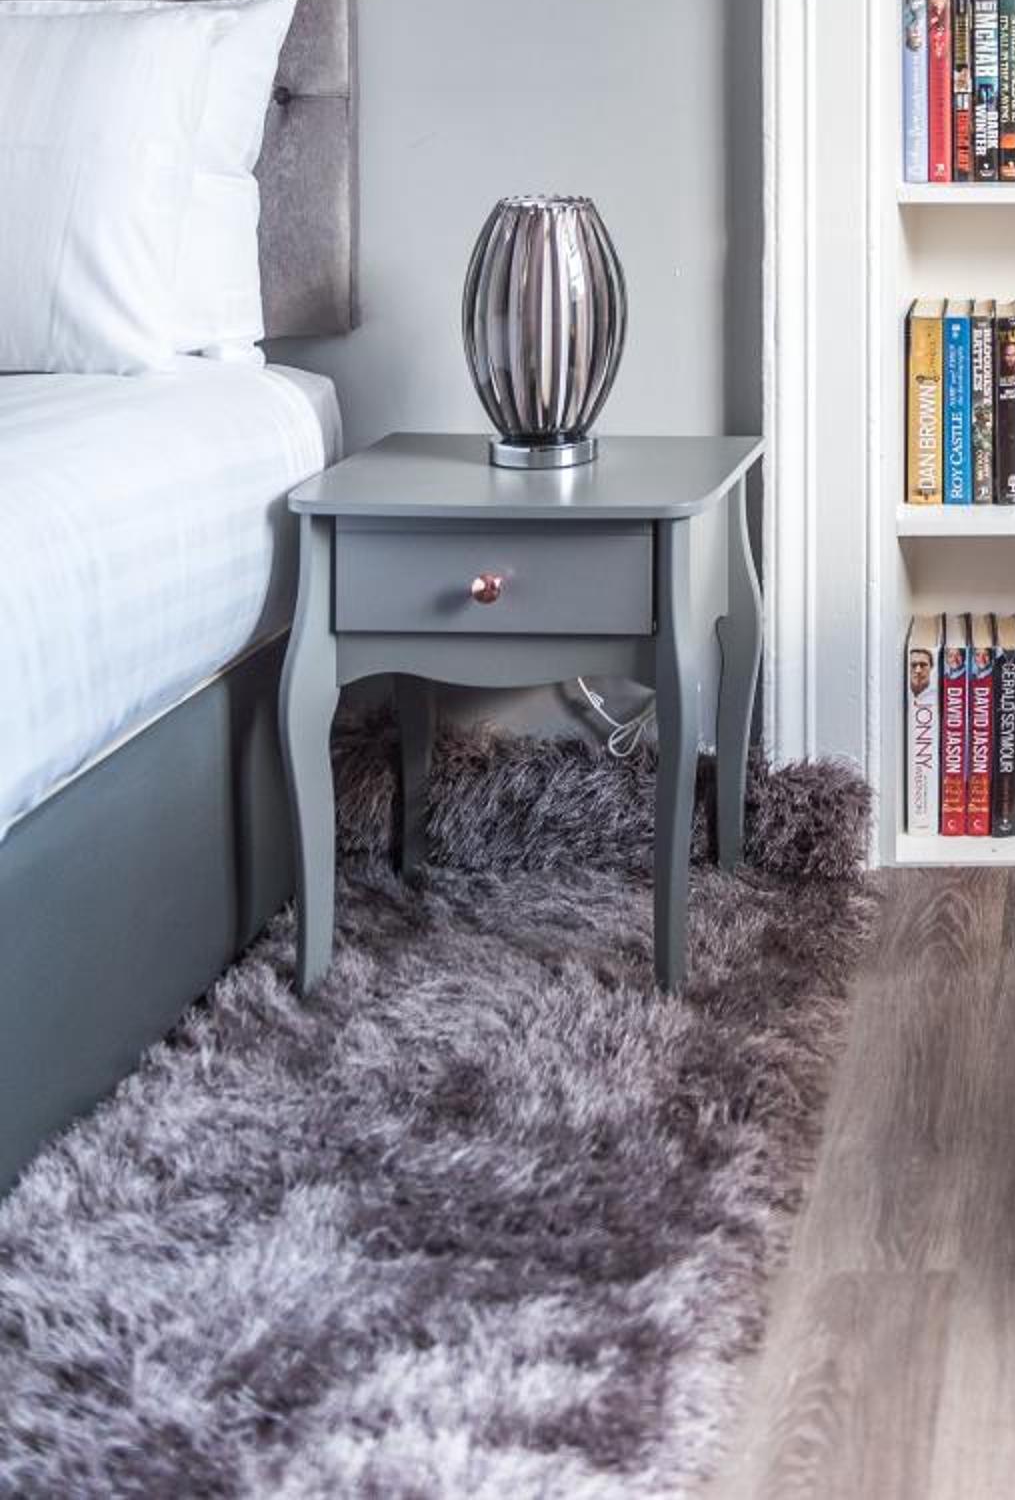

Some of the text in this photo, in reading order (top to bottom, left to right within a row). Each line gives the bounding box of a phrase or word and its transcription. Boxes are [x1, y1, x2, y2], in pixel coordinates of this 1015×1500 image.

[974, 104, 987, 156] WINTER
[987, 111, 999, 149] DARK
[973, 328, 983, 393] BATTLES
[983, 328, 993, 406] BLOODIEST
[919, 385, 938, 490] DAN BROWN
[949, 412, 964, 465] CASTLE
[951, 467, 964, 499] ROY
[914, 701, 934, 769] JONNY
[946, 686, 963, 773] DAVID JASON
[973, 686, 990, 773] DAVID JASON
[999, 713, 1015, 773] SEYMOUR
